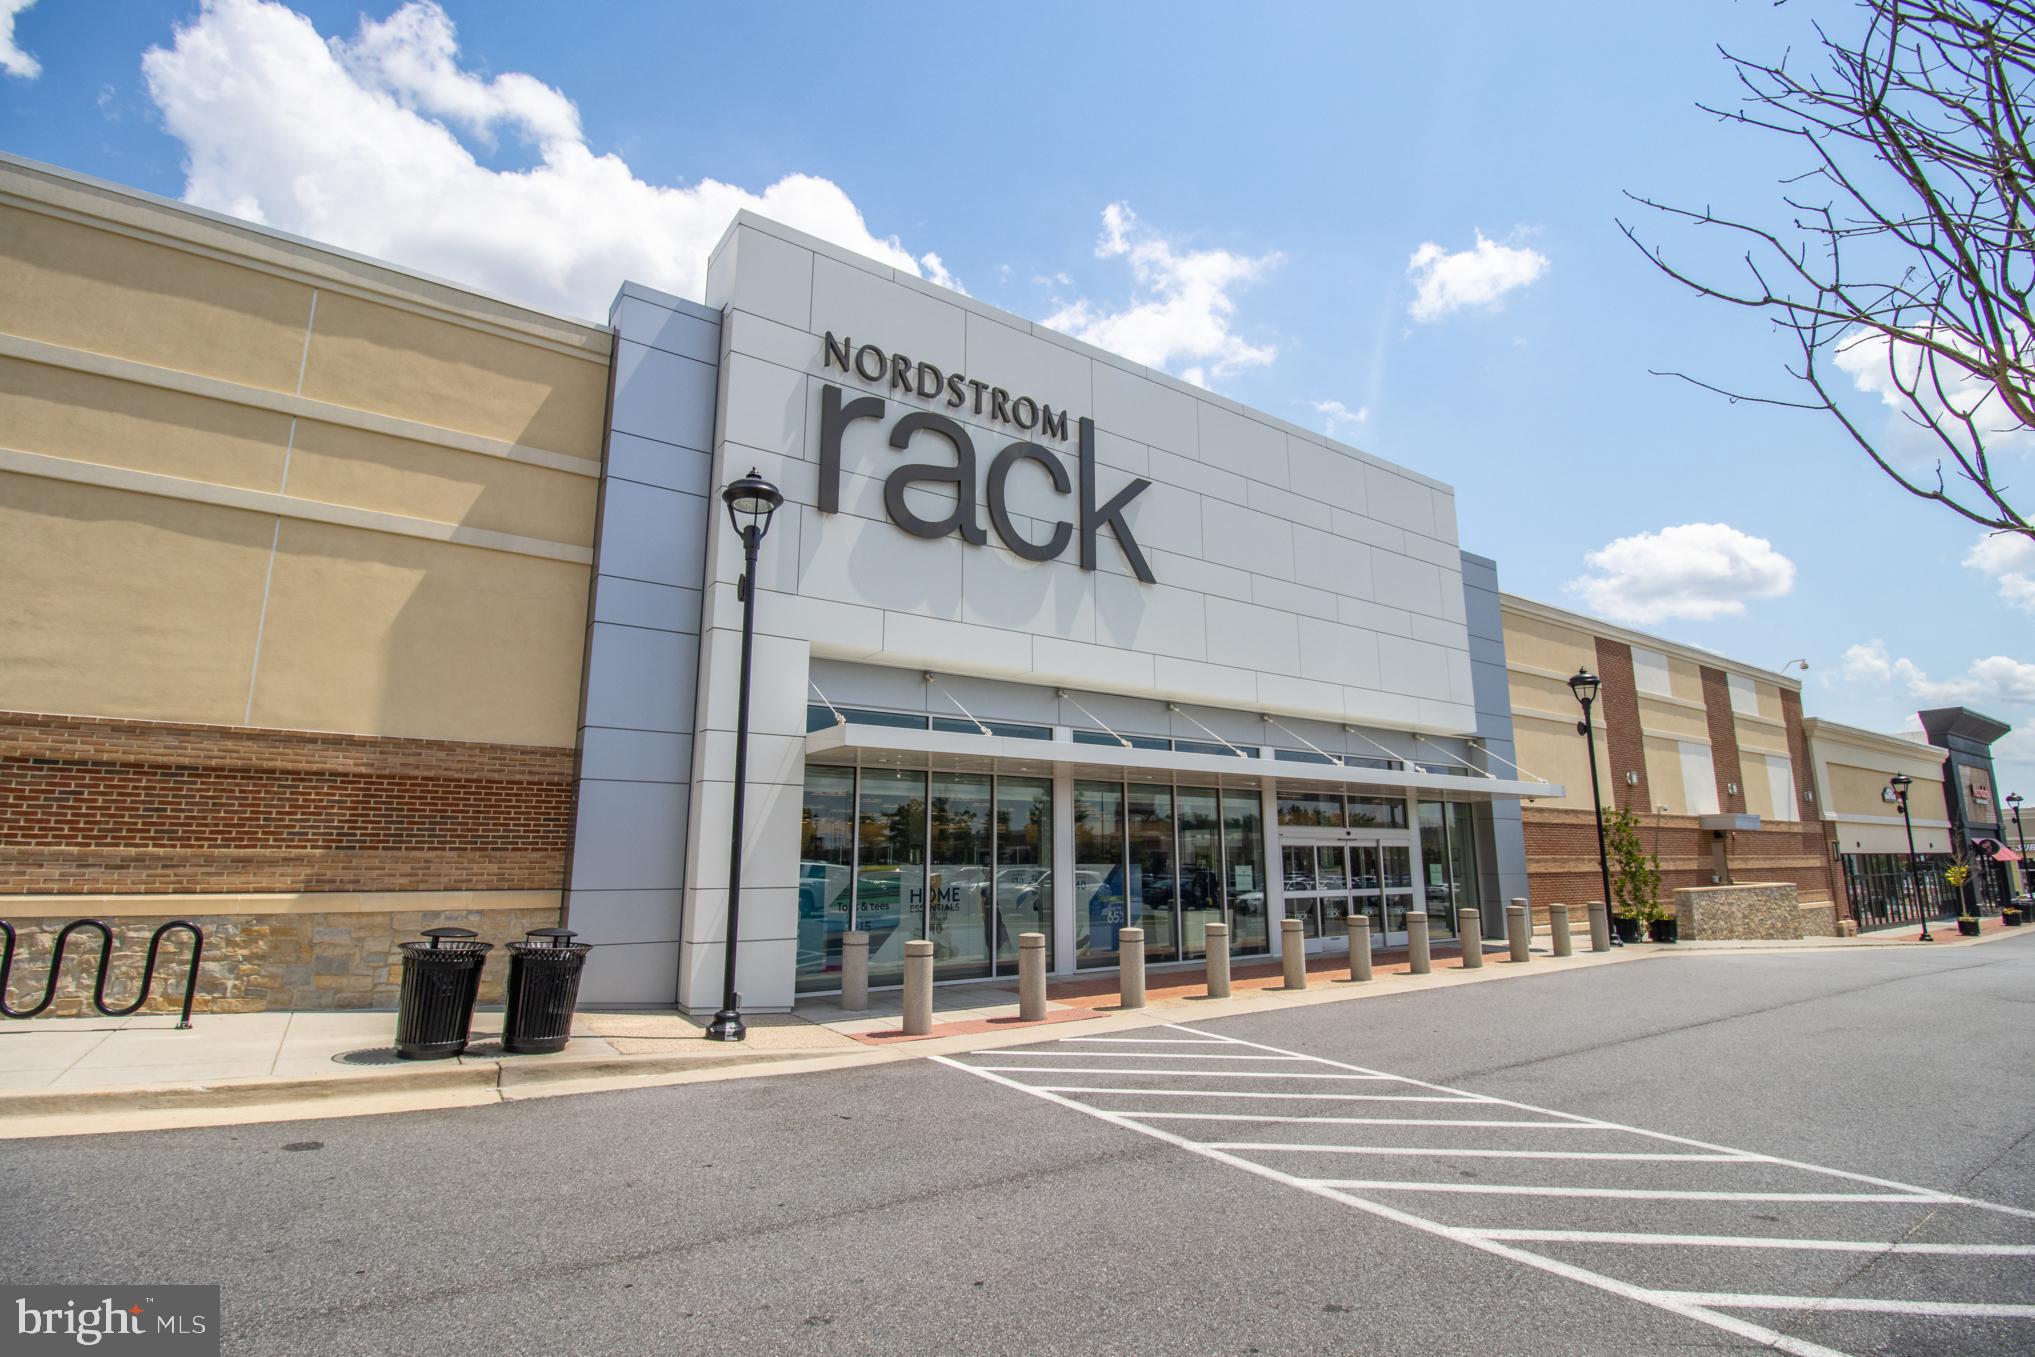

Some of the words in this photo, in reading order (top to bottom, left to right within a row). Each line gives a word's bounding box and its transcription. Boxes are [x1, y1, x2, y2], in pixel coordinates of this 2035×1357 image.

[824, 330, 1069, 441] NORDSTROM
[818, 384, 1157, 584] rack
[861, 901, 868, 912] &
[870, 903, 890, 911] tees
[909, 903, 960, 913] ESSNTIALS
